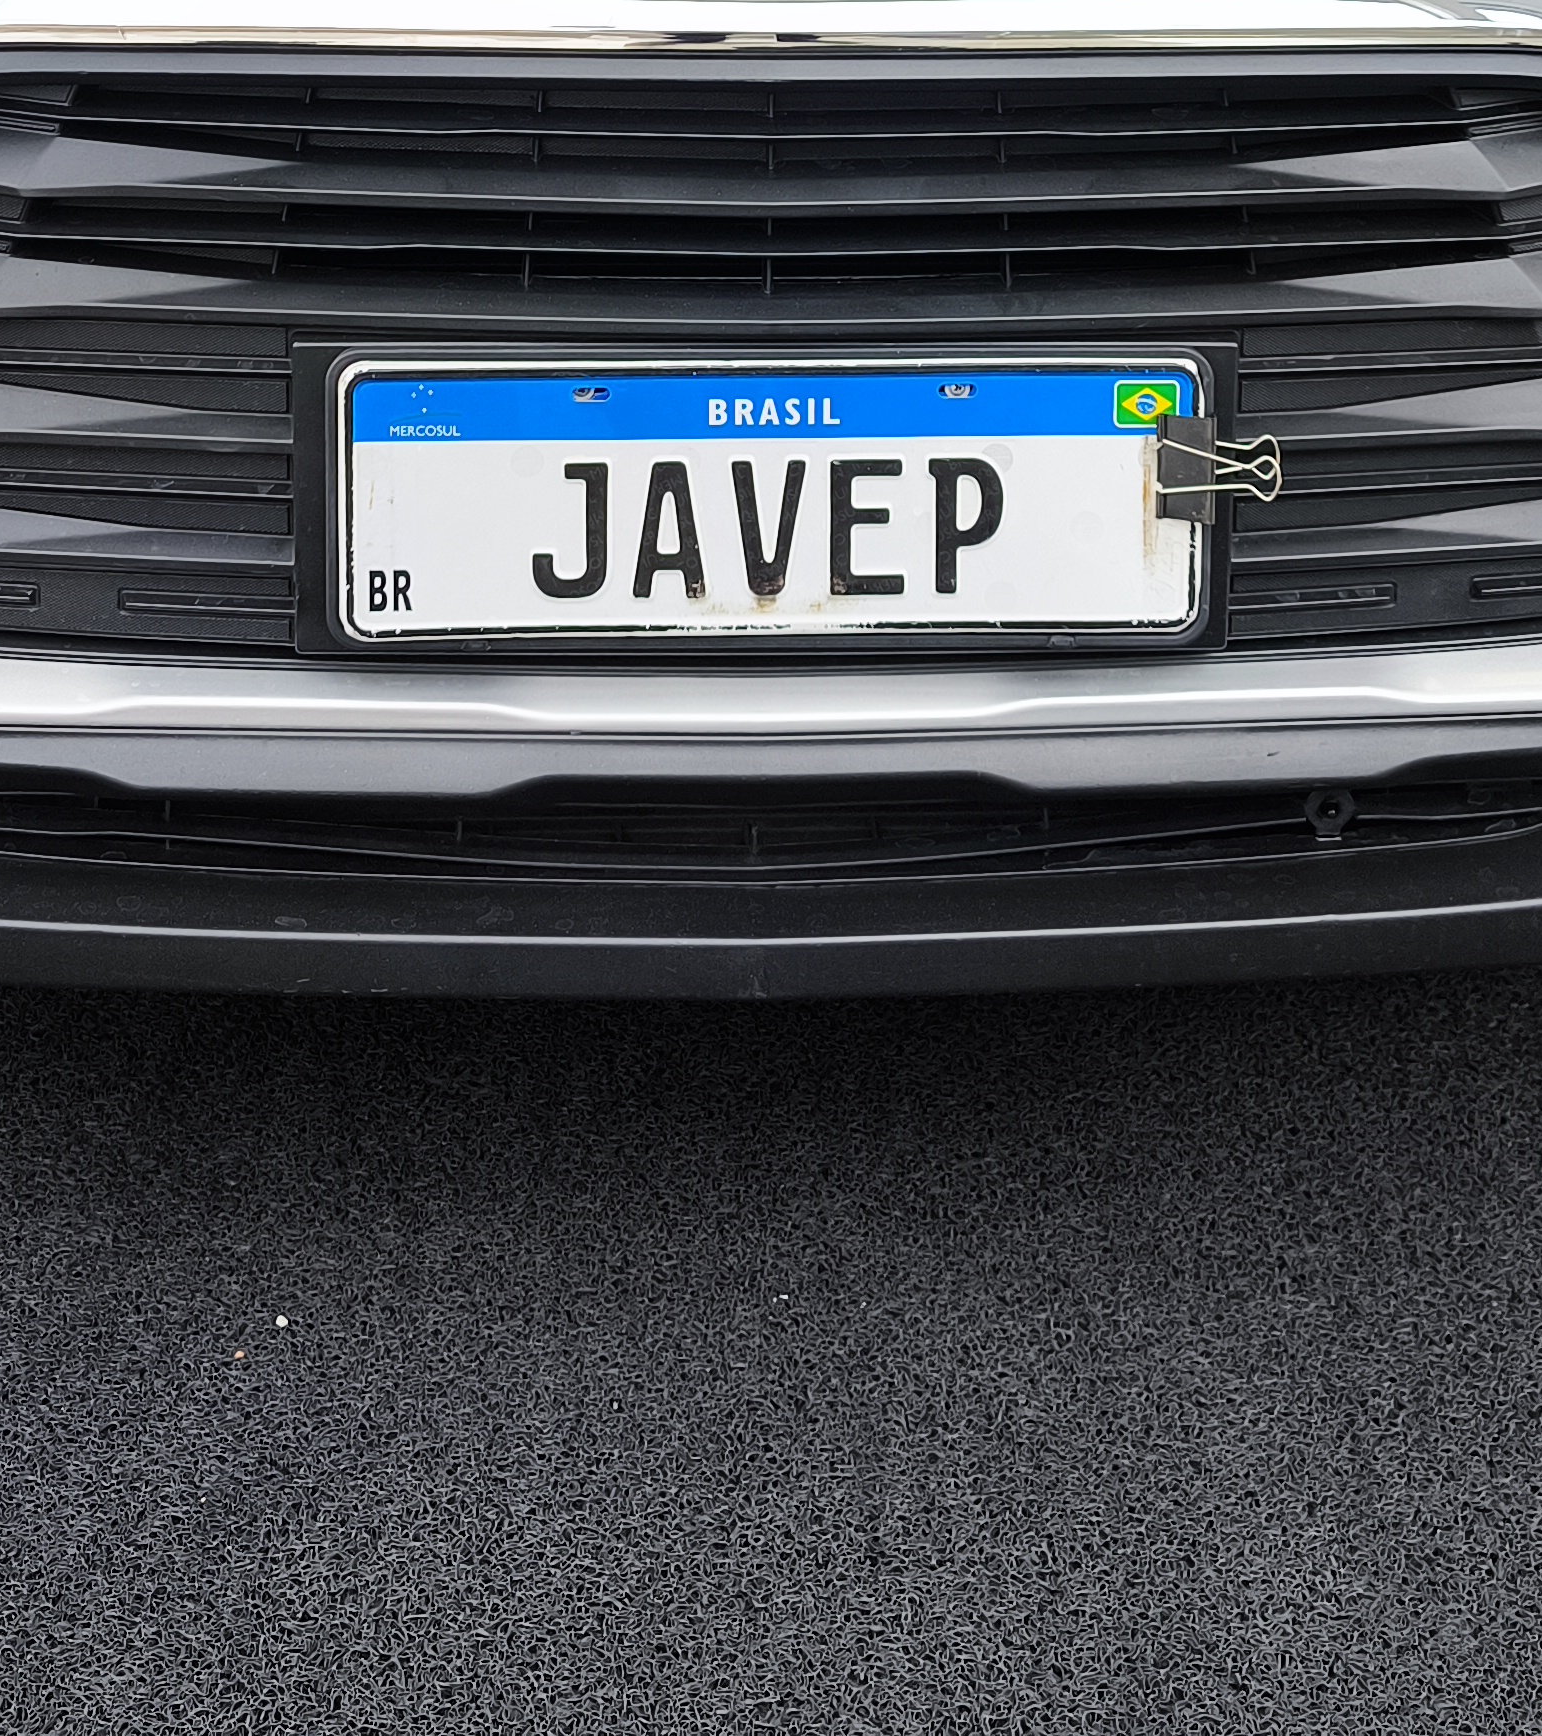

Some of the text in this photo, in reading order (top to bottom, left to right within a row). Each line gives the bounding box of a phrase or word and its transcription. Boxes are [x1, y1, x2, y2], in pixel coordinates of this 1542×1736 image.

[708, 397, 841, 426] BRASIL
[389, 424, 461, 438] MERCOSUL
[531, 458, 1004, 598] JAVEP
[369, 570, 413, 612] BR
